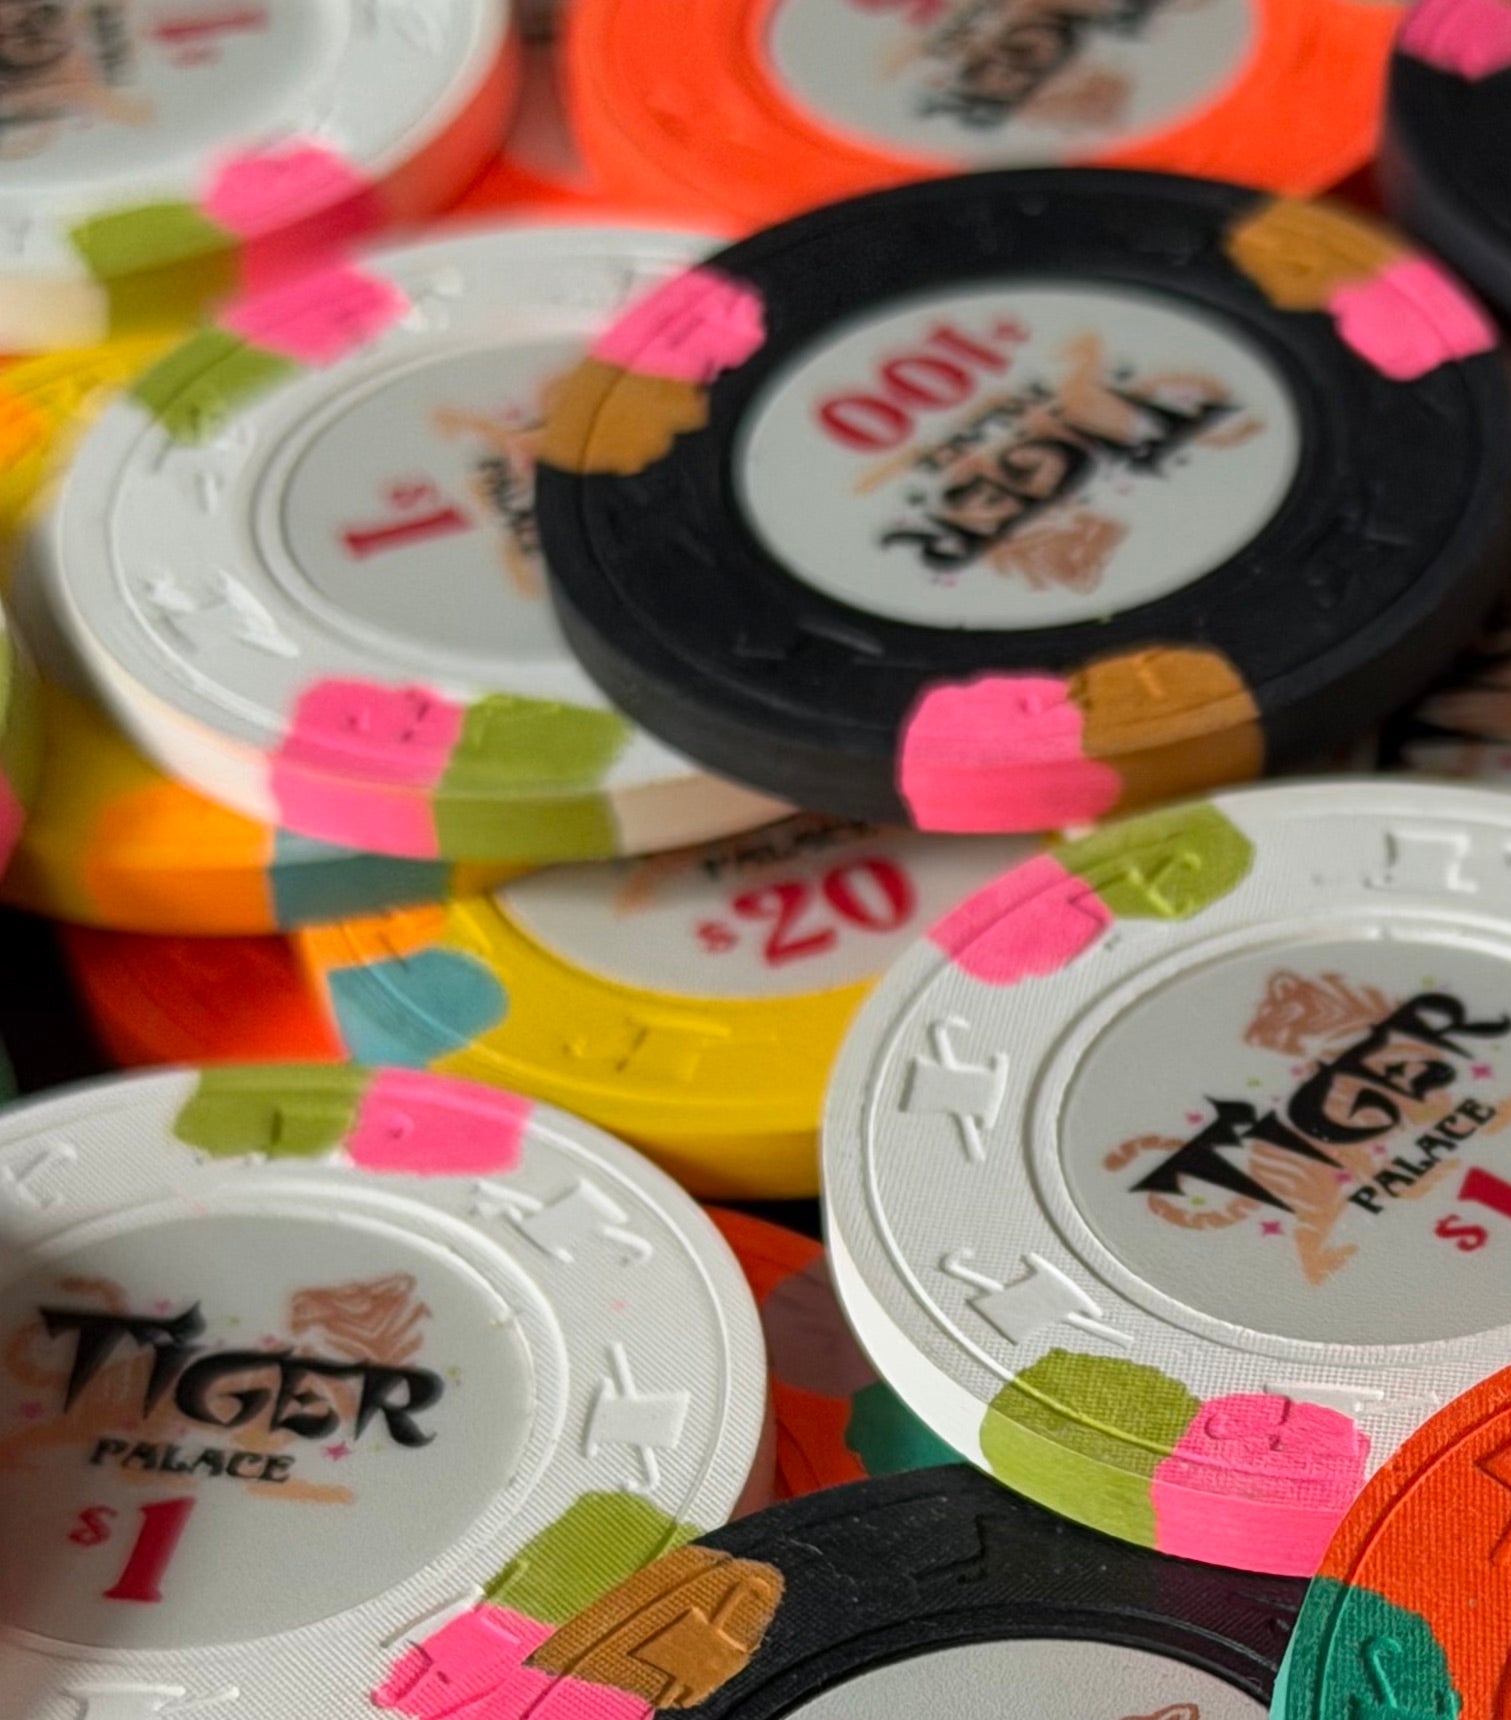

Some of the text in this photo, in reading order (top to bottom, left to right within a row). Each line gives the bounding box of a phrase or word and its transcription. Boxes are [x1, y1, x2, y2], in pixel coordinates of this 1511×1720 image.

[816, 319, 1030, 452] $100
[880, 381, 1247, 575] TIGER
[695, 854, 916, 967] $20
[1346, 1097, 1496, 1215] PALACE
[40, 1300, 443, 1447] TIGER
[88, 1437, 296, 1483] PALACE
[67, 1497, 195, 1604] $1
